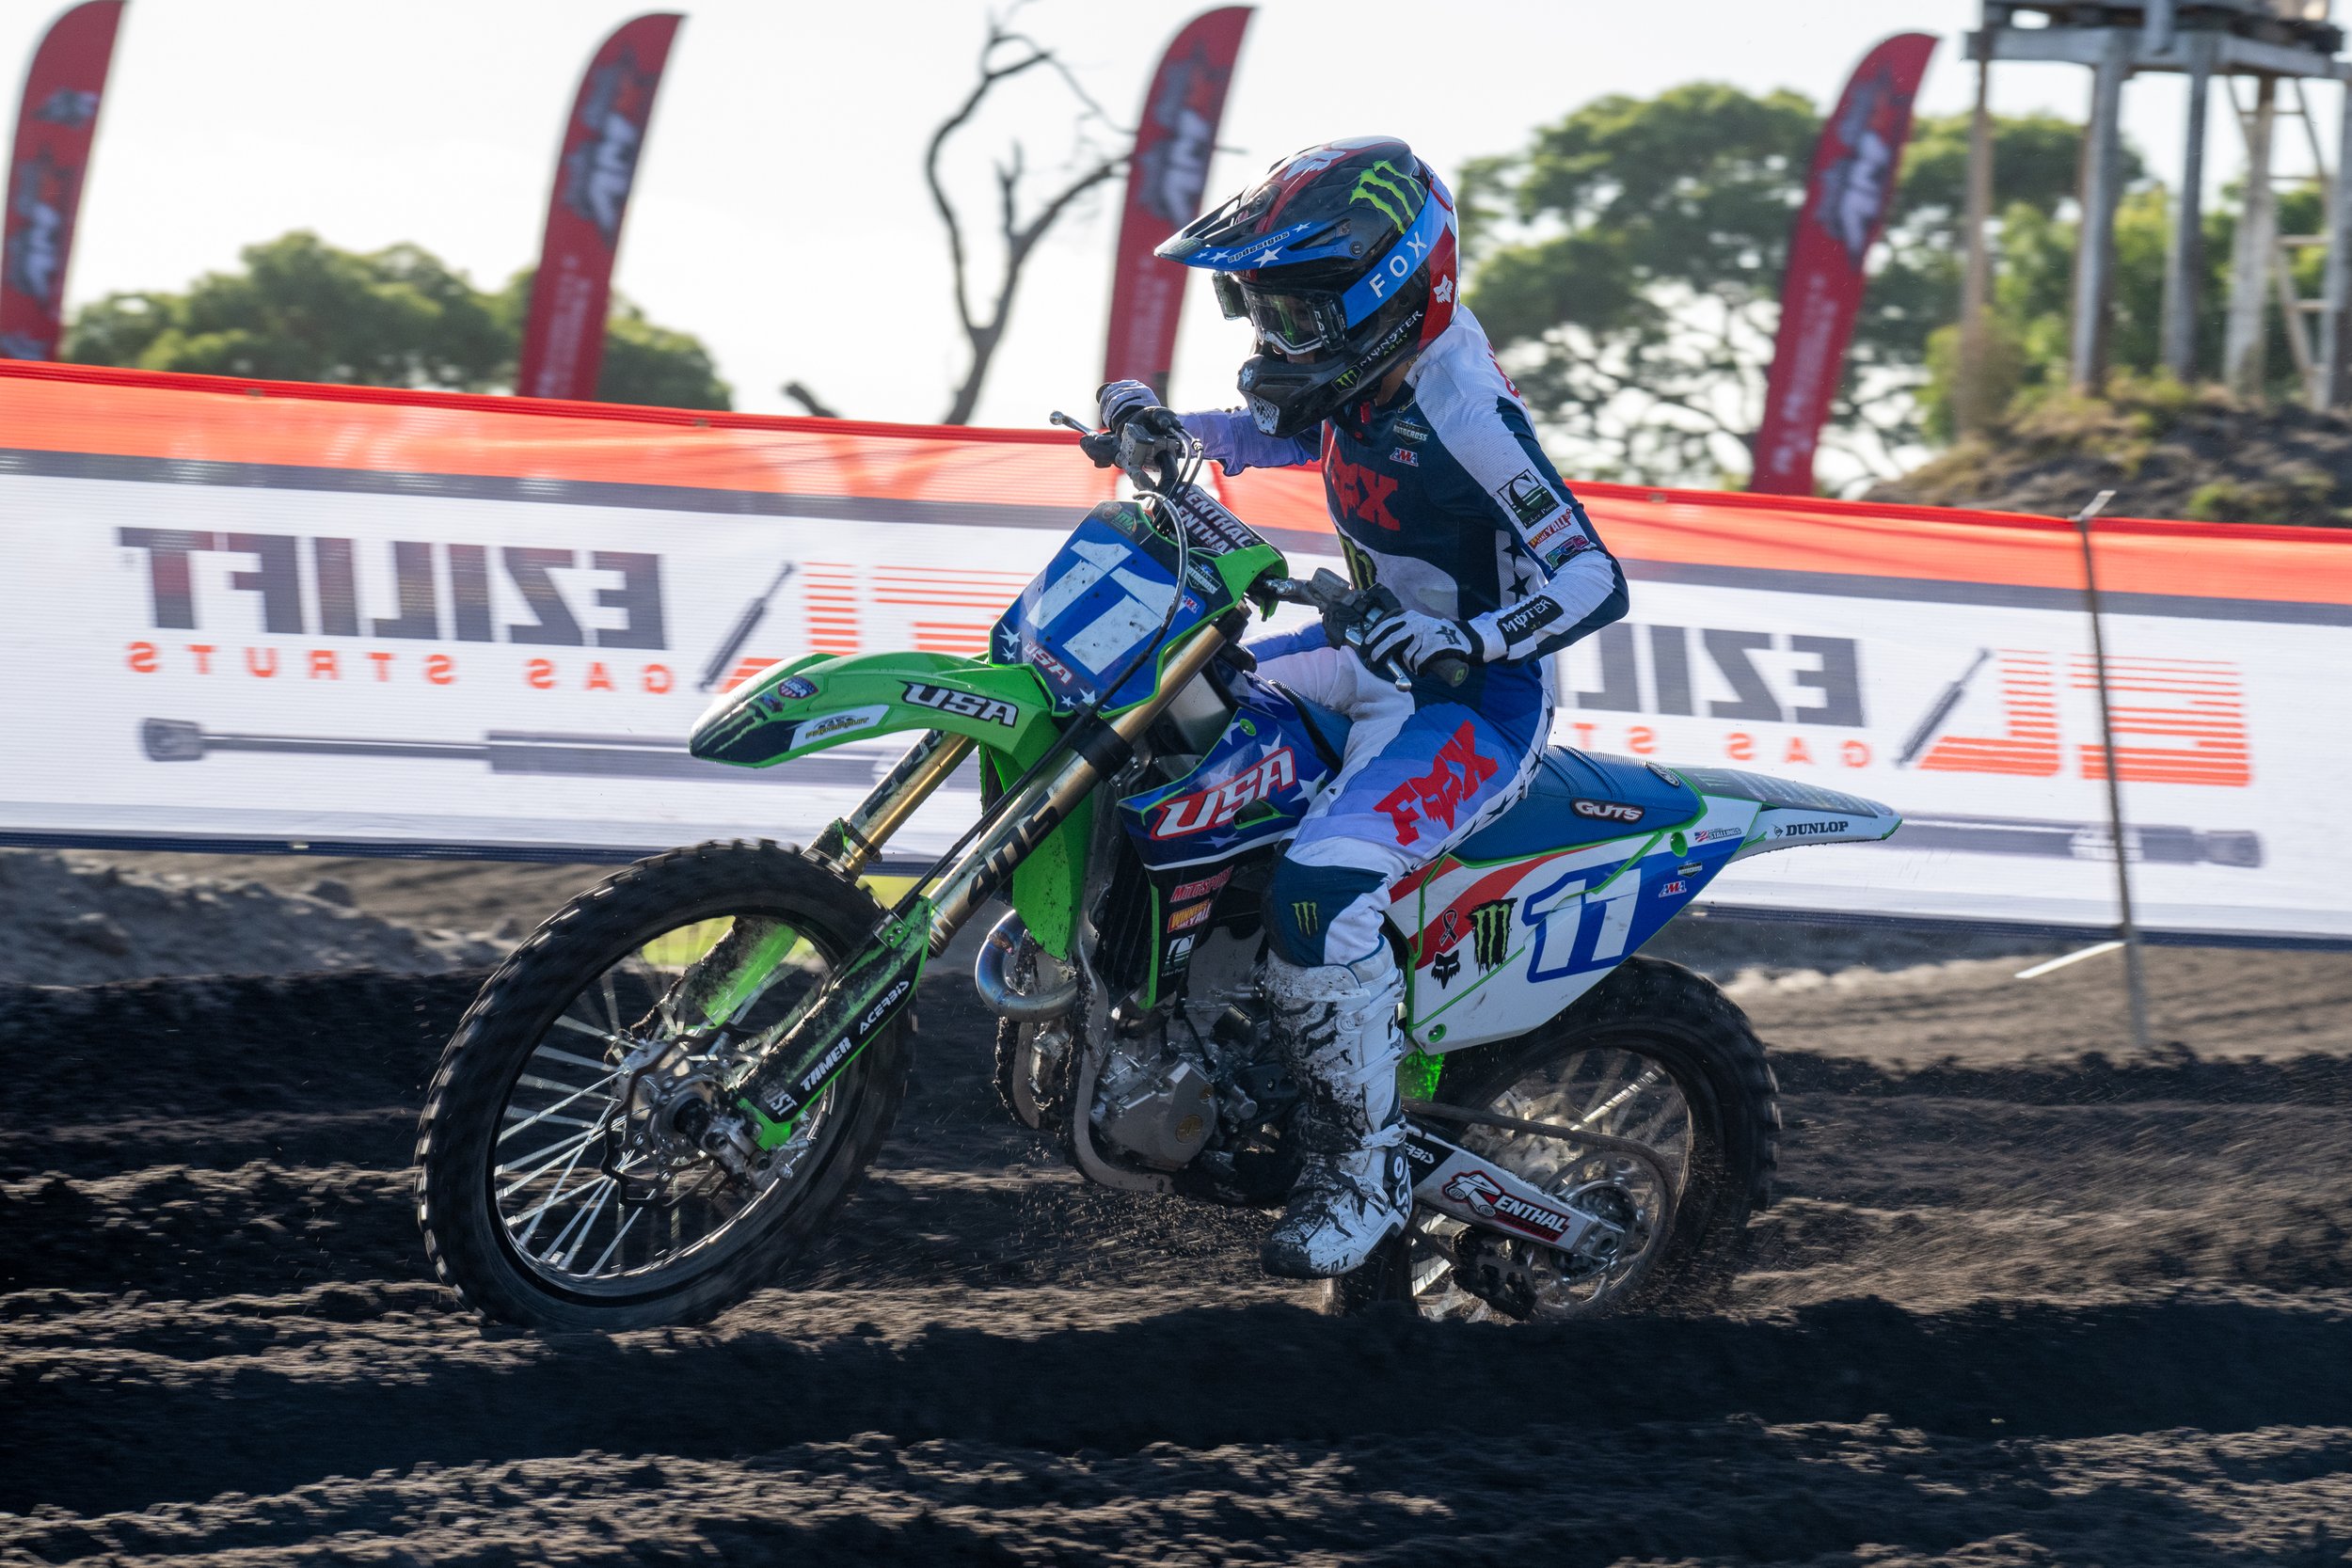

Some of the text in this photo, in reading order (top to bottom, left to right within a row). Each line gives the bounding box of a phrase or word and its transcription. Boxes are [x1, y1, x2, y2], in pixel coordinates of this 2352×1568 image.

[1369, 231, 1428, 298] FOX
[1177, 485, 1251, 547] ENTHAL
[1025, 539, 1184, 675] 11
[1024, 641, 1074, 686] USA
[898, 680, 1019, 728] USA
[1152, 746, 1295, 840] USA
[1575, 801, 1644, 822] GUTS
[1786, 820, 1850, 837] DUNLOP
[1659, 879, 1687, 897] AMA
[1521, 865, 1642, 983] 11
[1443, 1172, 1568, 1234] RENTHAL
